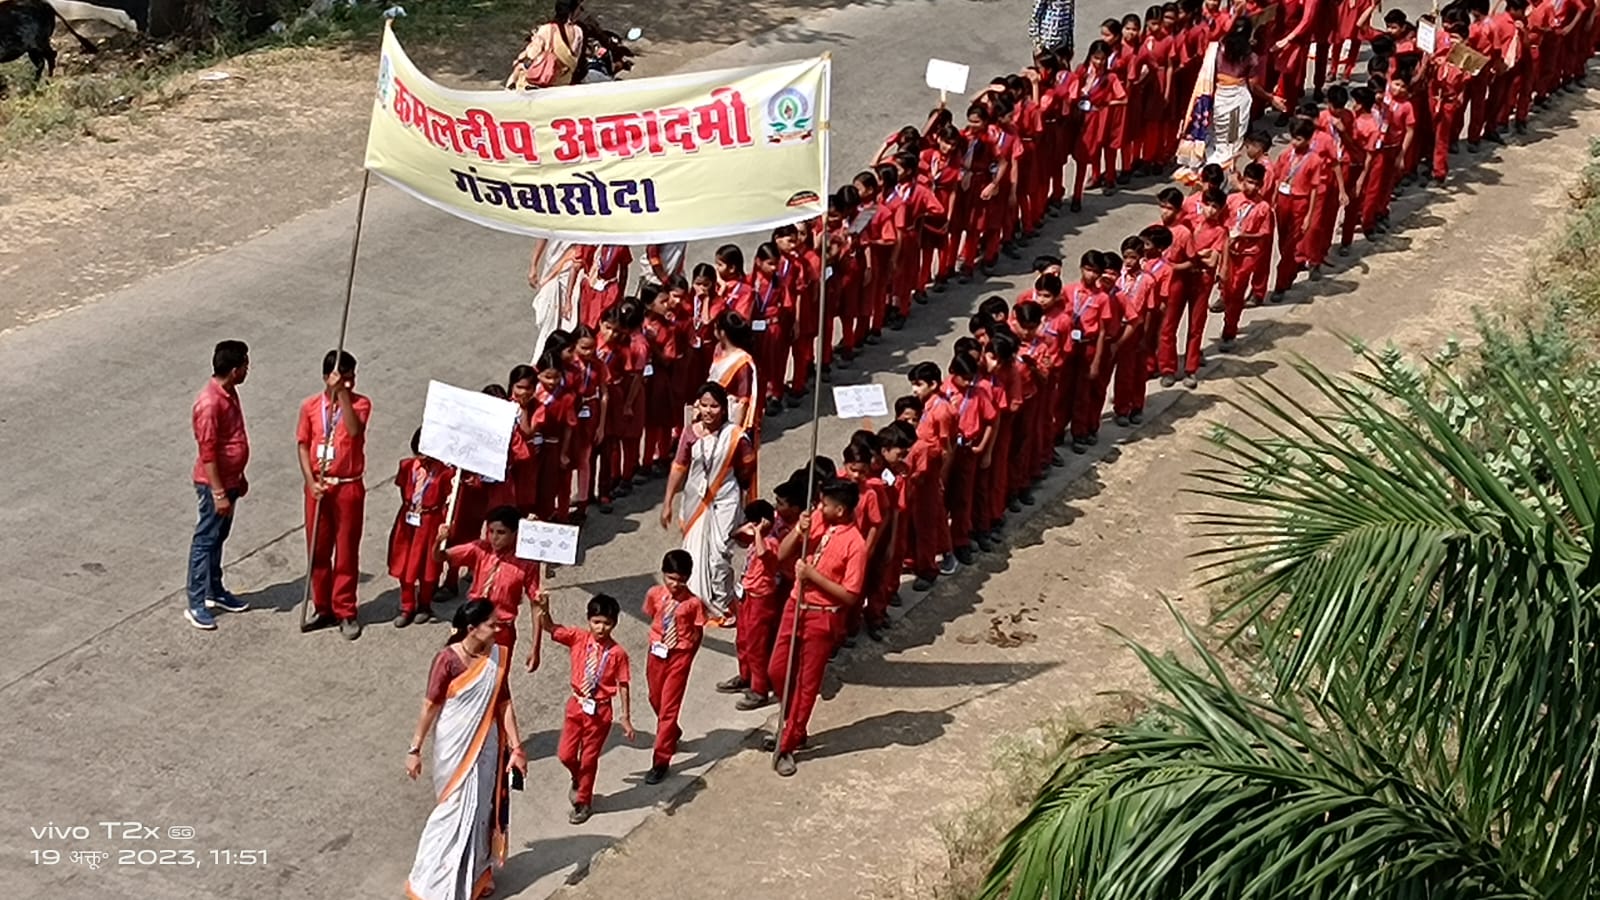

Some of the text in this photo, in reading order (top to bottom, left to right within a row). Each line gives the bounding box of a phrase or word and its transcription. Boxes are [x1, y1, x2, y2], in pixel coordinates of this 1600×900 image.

[393, 76, 539, 163] कमलदीप
[550, 86, 752, 163] अकादमी
[449, 166, 660, 216] गंजबासौदा
